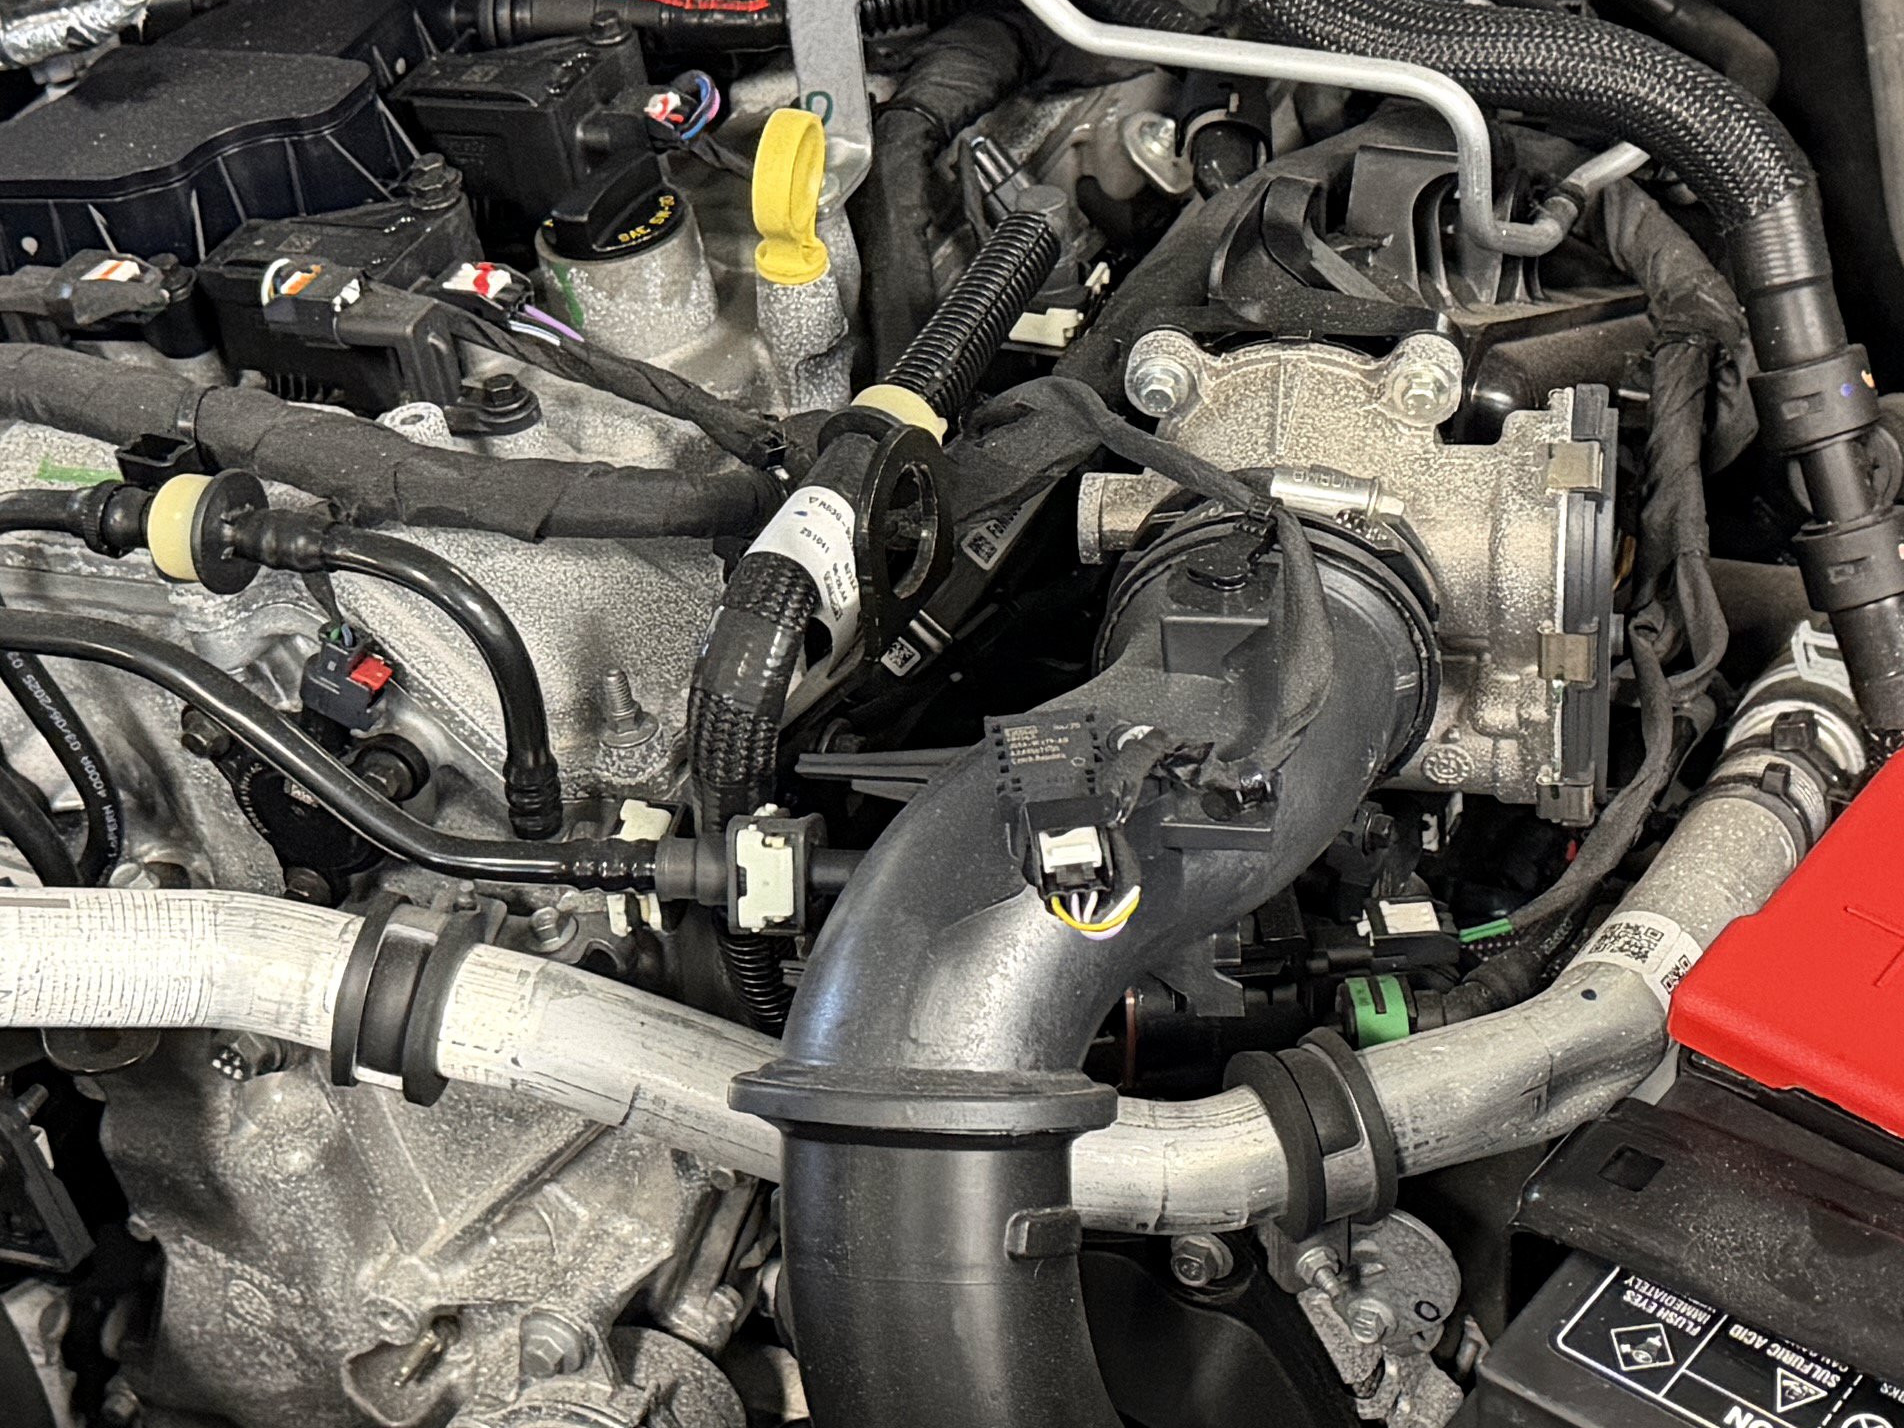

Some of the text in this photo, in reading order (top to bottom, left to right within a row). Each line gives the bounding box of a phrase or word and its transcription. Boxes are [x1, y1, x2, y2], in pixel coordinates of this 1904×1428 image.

[1620, 1287, 1657, 1315] EYES
[1622, 1273, 1711, 1326] IMMEDIATELY
[1655, 1305, 1702, 1337] FLUSH
[1727, 1320, 1768, 1352] ACID
[1765, 1340, 1842, 1391] SULFURIC
